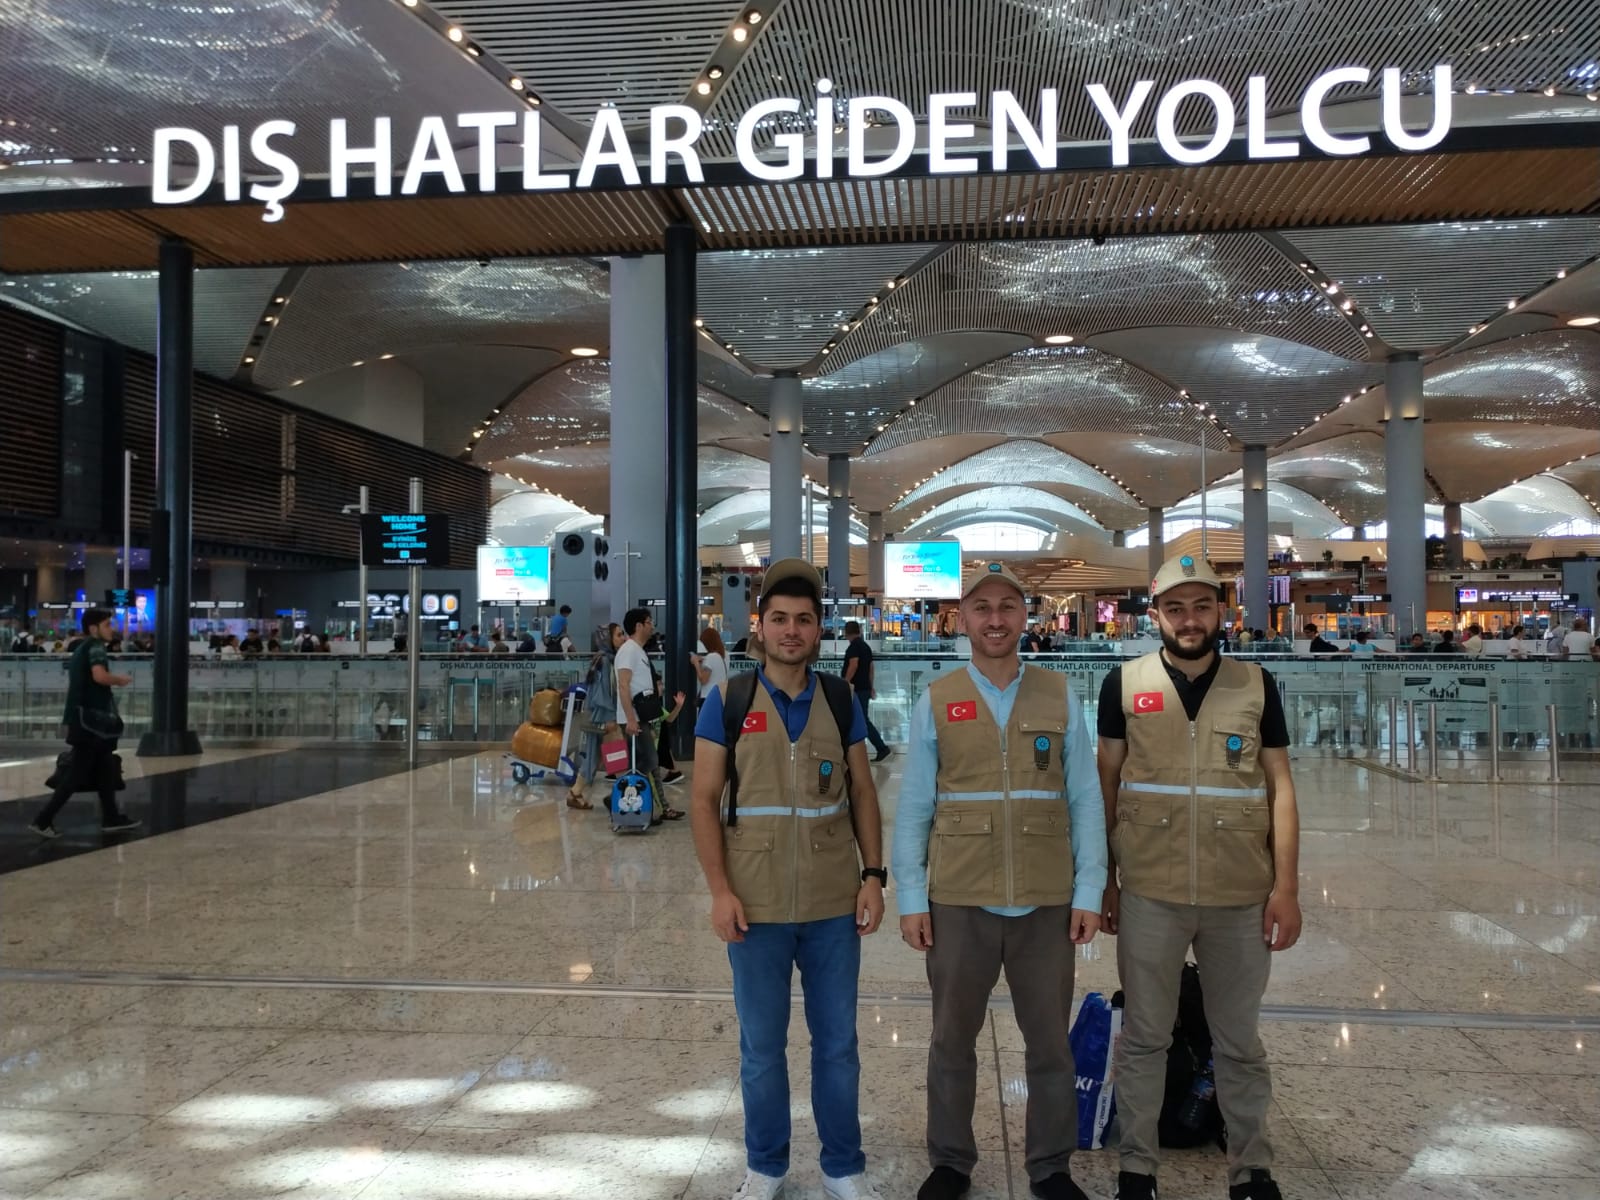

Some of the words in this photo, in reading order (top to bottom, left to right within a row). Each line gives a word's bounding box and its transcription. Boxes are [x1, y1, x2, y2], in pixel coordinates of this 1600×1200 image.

[152, 120, 299, 222] DIŞ
[329, 103, 704, 197] HATLAR
[735, 78, 1058, 181] GİDEN
[1086, 65, 1453, 167] YOLCU
[382, 515, 426, 523] WELCOME
[455, 662, 484, 670] HATLAR
[511, 662, 537, 670] YOLCU
[1361, 663, 1434, 671] INTERNATIONAL
[1436, 663, 1496, 671] DEPARTURES
[1074, 1075, 1094, 1092] KI
